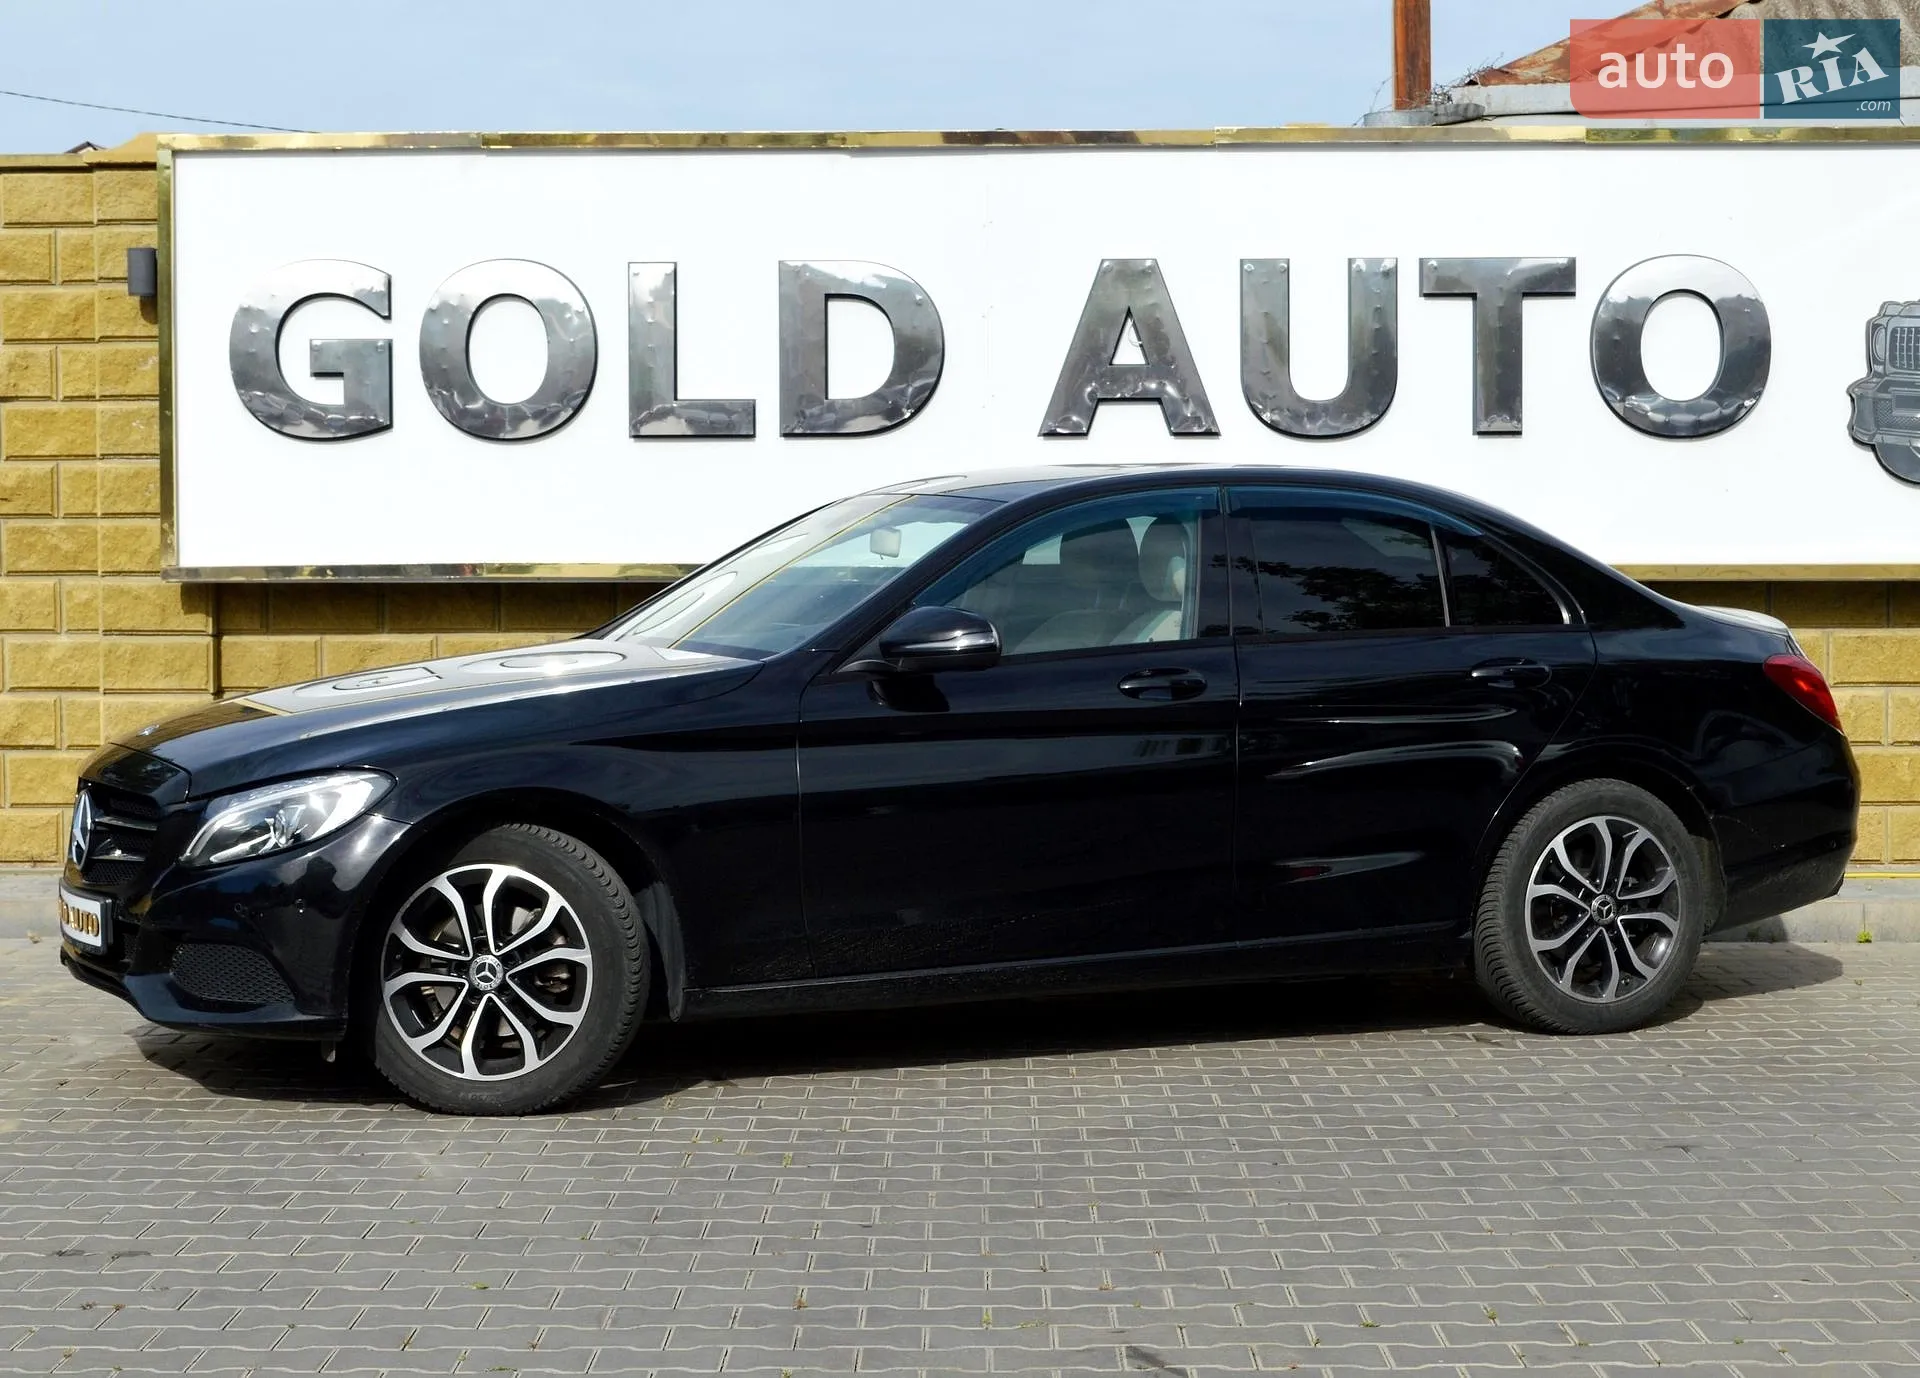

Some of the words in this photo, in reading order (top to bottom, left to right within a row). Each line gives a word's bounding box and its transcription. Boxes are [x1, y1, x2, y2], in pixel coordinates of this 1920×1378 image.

[229, 258, 945, 442] GOLD
[1037, 254, 1772, 440] AUTO
[69, 905, 100, 937] AUTO
